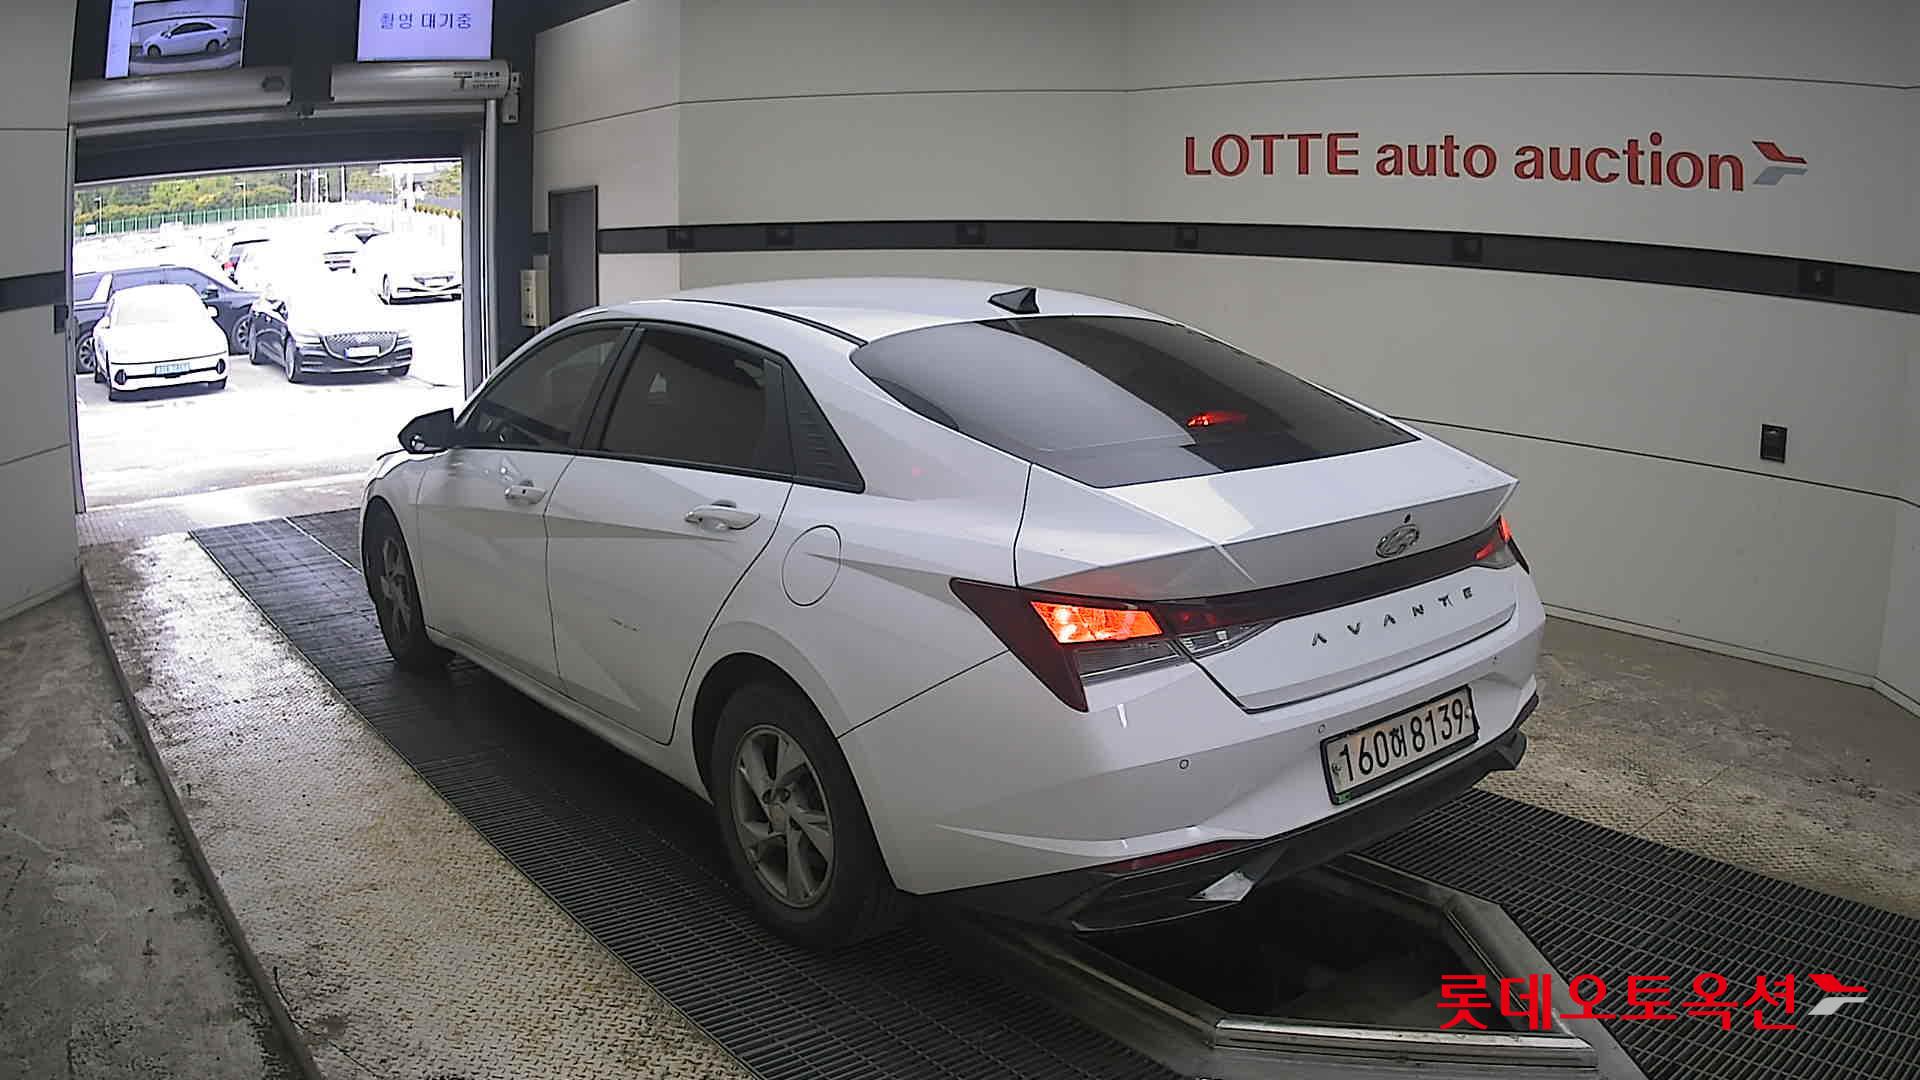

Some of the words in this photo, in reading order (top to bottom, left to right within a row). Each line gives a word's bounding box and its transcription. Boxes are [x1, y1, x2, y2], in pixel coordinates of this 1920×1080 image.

[421, 12, 472, 29] 대기중
[1184, 132, 1359, 176] LOTTE
[1376, 134, 1497, 178] auto
[1514, 132, 1744, 191] auction
[1311, 586, 1473, 646] AVANTE
